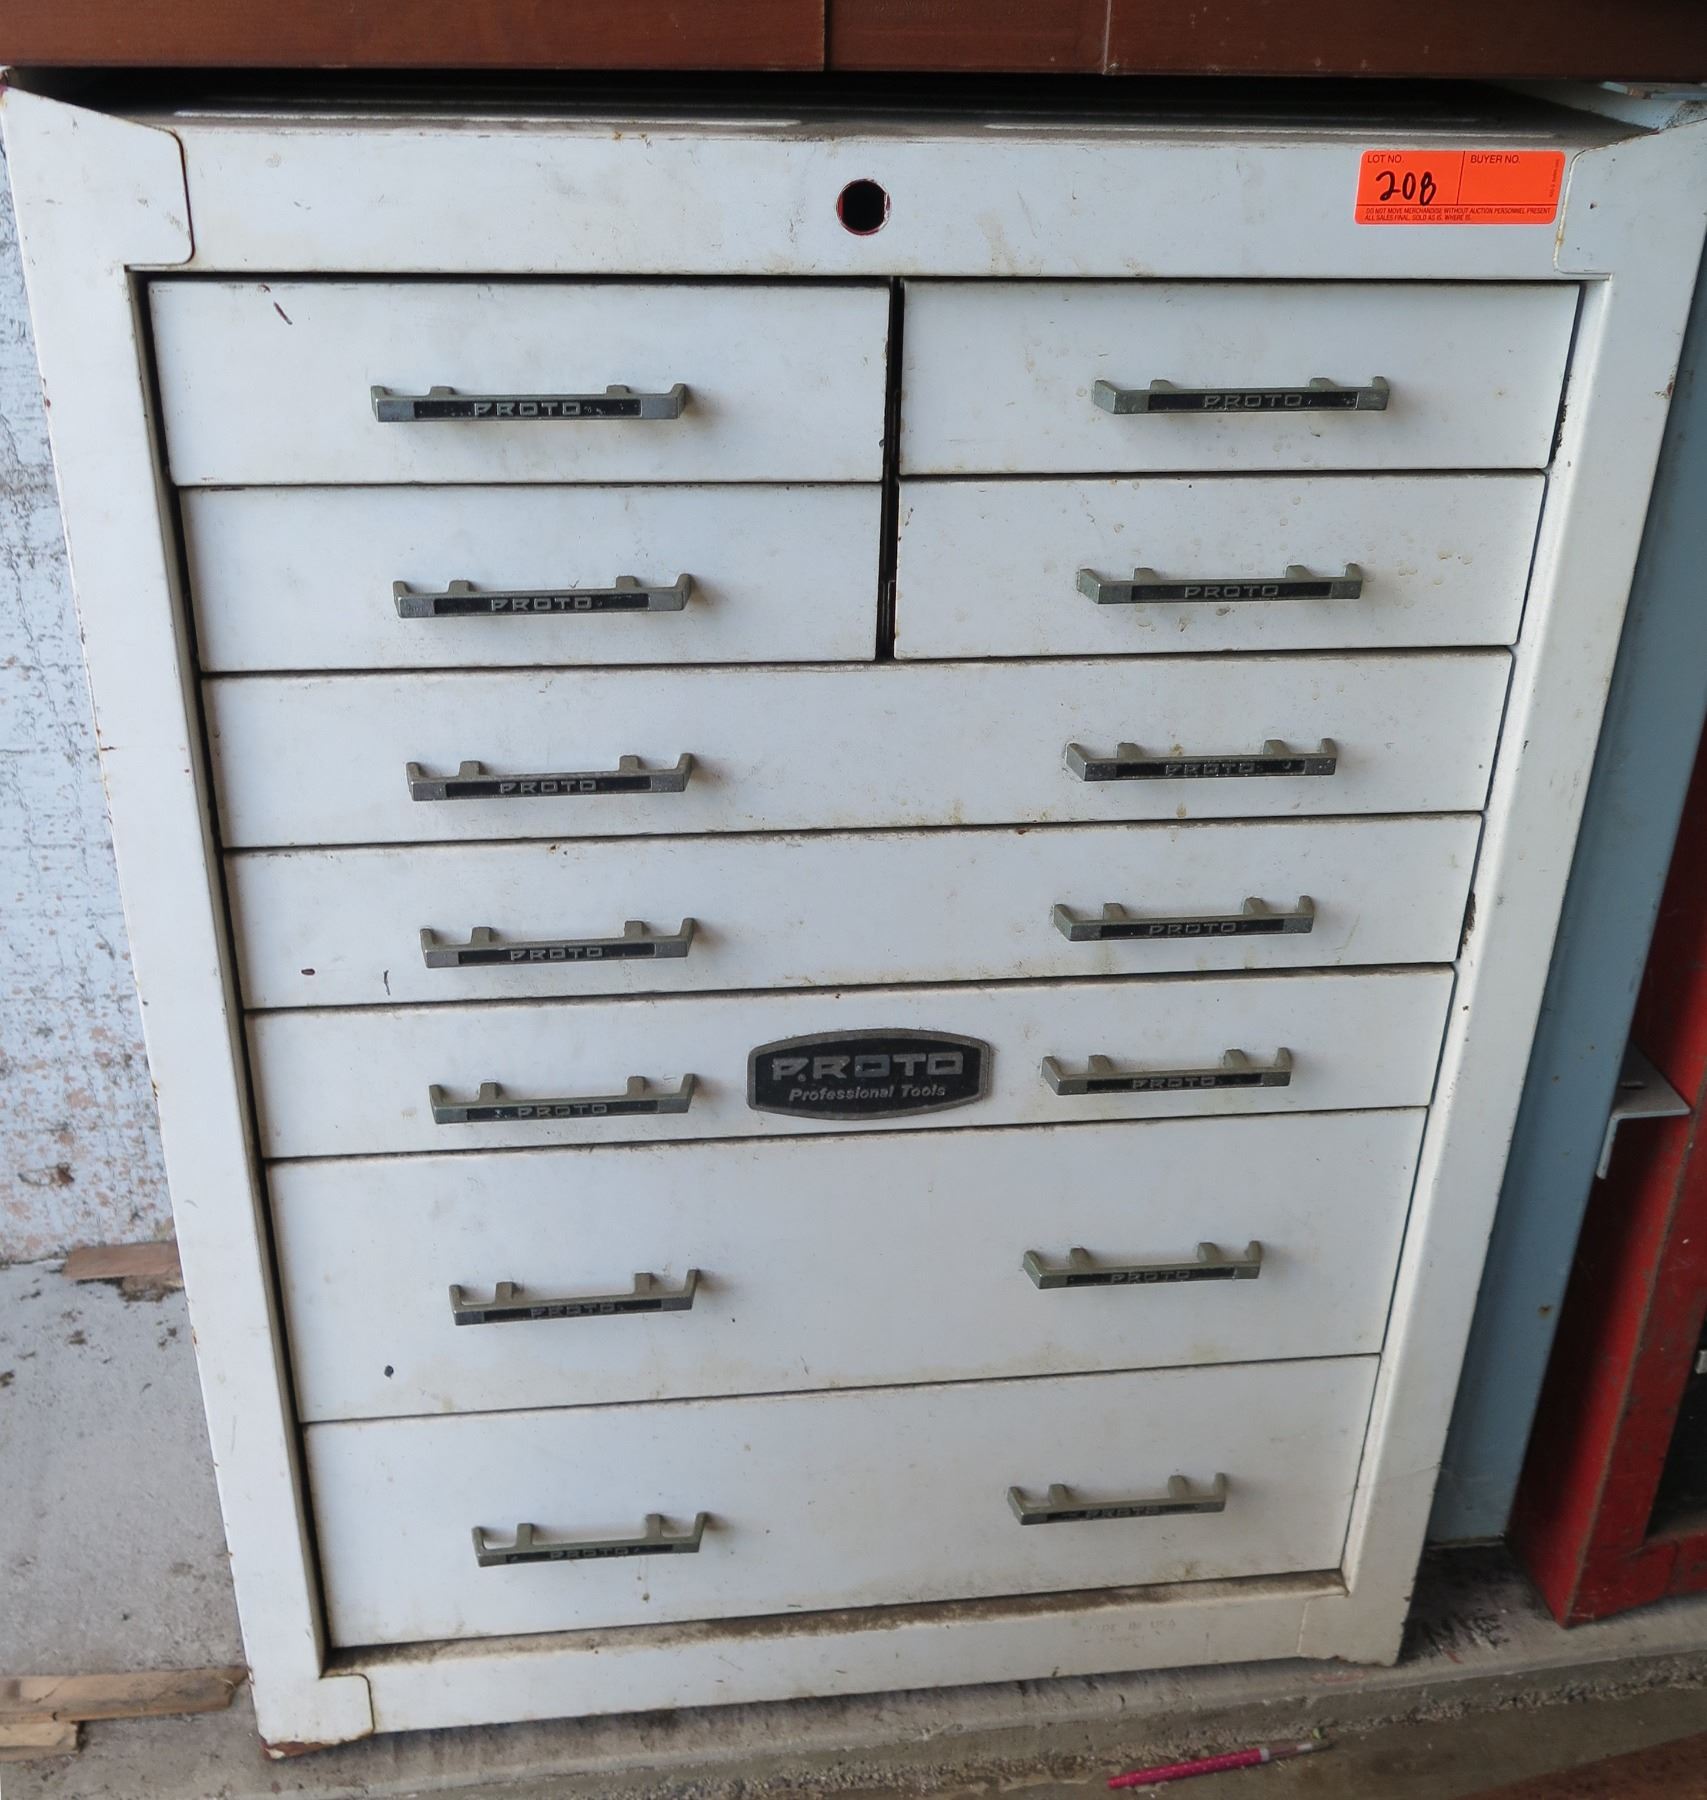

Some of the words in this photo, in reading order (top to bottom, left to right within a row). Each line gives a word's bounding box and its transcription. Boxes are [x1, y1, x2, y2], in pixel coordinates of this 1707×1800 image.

[1367, 154, 1386, 164] LOT
[1387, 154, 1405, 164] NO.
[1470, 154, 1502, 164] BUYER
[1504, 154, 1521, 164] NO.
[1375, 170, 1437, 206] 208
[1526, 207, 1551, 215] PRESENT
[1203, 394, 1303, 408] PROTO
[474, 402, 581, 417] PROTO
[1184, 585, 1279, 599] PROTO
[491, 596, 592, 611] PROTO
[1165, 762, 1256, 776] PROTO
[500, 779, 597, 794] PROTO
[1149, 922, 1236, 935] PROTO
[510, 947, 603, 961] PROTO
[771, 1051, 964, 1081] PROTO
[1132, 1076, 1216, 1089] PROTO
[789, 1085, 893, 1101] Professional
[901, 1083, 946, 1097] Tools
[518, 1103, 607, 1118] PROTO
[1111, 1270, 1190, 1284] PROTO
[530, 1303, 615, 1318] PROTO
